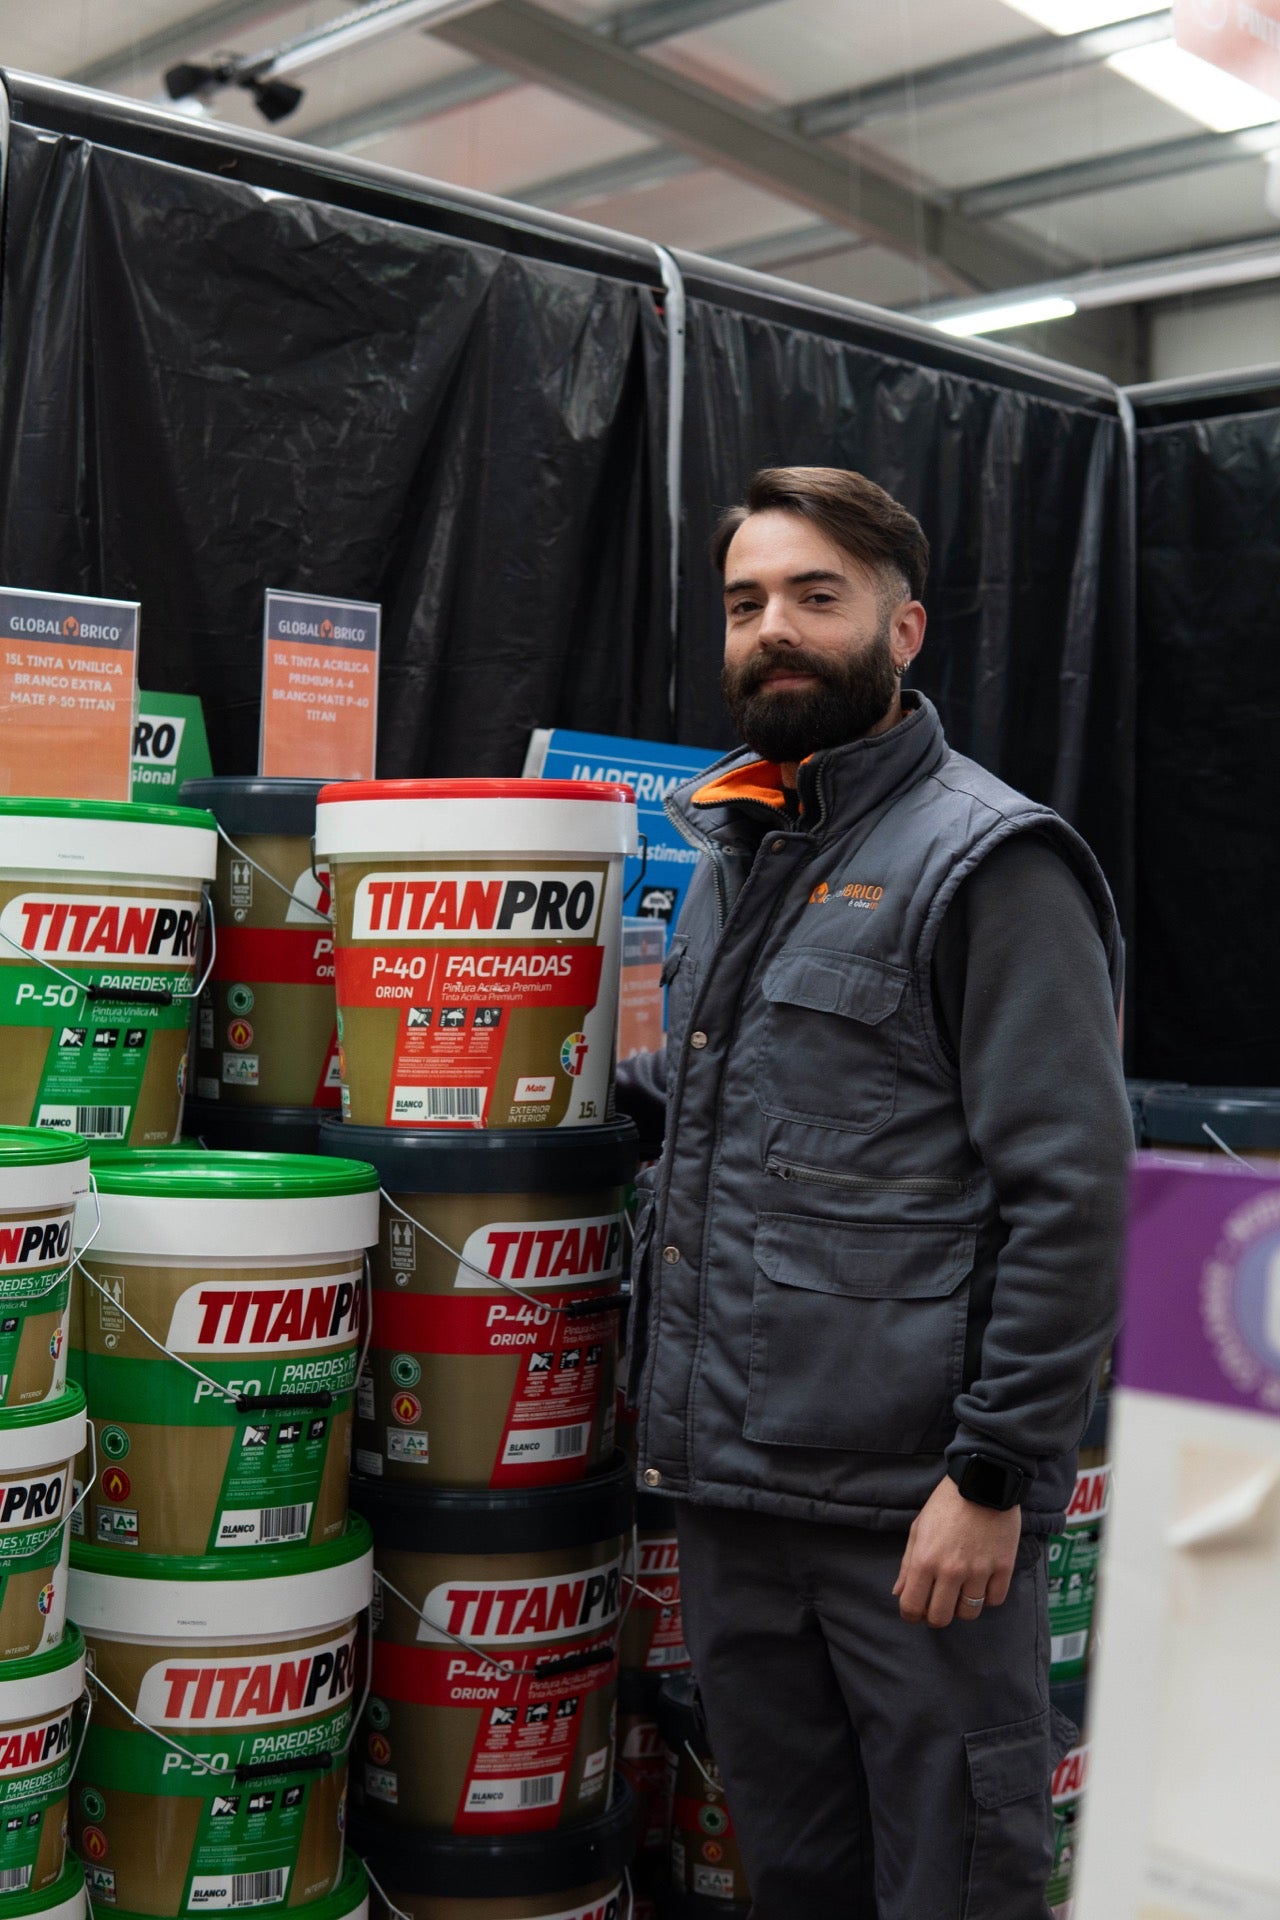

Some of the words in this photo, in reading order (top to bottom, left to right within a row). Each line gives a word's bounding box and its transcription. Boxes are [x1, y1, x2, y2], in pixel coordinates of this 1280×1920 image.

[10, 616, 62, 636] GLOBAL
[80, 623, 120, 641] BRICO
[278, 619, 320, 637] GLOBAL
[333, 625, 366, 642] BRICO
[5, 652, 24, 667] 15L
[26, 654, 64, 670] TINTA
[273, 653, 289, 667] 15L
[291, 655, 320, 669] TINTA
[14, 672, 69, 689] BRANCO
[71, 677, 112, 693] EXTRA
[288, 672, 334, 688] PREMIUM
[10, 691, 45, 706] MATE
[78, 697, 116, 712] TITAN
[272, 688, 315, 703] BRANCO
[317, 692, 345, 706] MATE
[306, 708, 337, 722] TITAN
[571, 764, 690, 802] IMPERM
[367, 879, 595, 931] TITANPRO
[371, 956, 427, 980] P-40
[445, 954, 573, 977] FACHADAS
[16, 983, 78, 1007] P-50
[99, 975, 167, 993] PAREDES
[375, 985, 414, 999] ORION
[442, 982, 476, 993] Pintura
[511, 981, 552, 992] Premium
[441, 992, 460, 1001] Tinta
[488, 992, 523, 1001] Premium
[92, 1005, 123, 1017] Pintura
[525, 1084, 547, 1093] Mate
[396, 1100, 423, 1109] BLANCO
[509, 1104, 551, 1115] EXTERIOR
[40, 1118, 72, 1127] BLANCO
[507, 1113, 548, 1123] INTERIOR
[486, 1303, 550, 1328] P-40
[490, 1332, 538, 1346] ORION
[194, 1378, 261, 1404] P-50
[282, 1357, 344, 1382] PAREDES
[406, 1436, 425, 1448] A+
[509, 1442, 541, 1452] BLANCO
[0, 1477, 61, 1523] PRO
[116, 1515, 135, 1529] A+
[222, 1524, 255, 1534] BLANCO
[446, 1659, 513, 1682] P-40
[450, 1686, 499, 1700] ORION
[162, 1752, 229, 1775] P-50
[252, 1724, 325, 1755] PAREDES
[7, 1770, 54, 1794] PAREDES
[471, 1792, 504, 1800] BLANCO
[95, 1872, 113, 1887] A+
[193, 1888, 227, 1897] BLANCO
